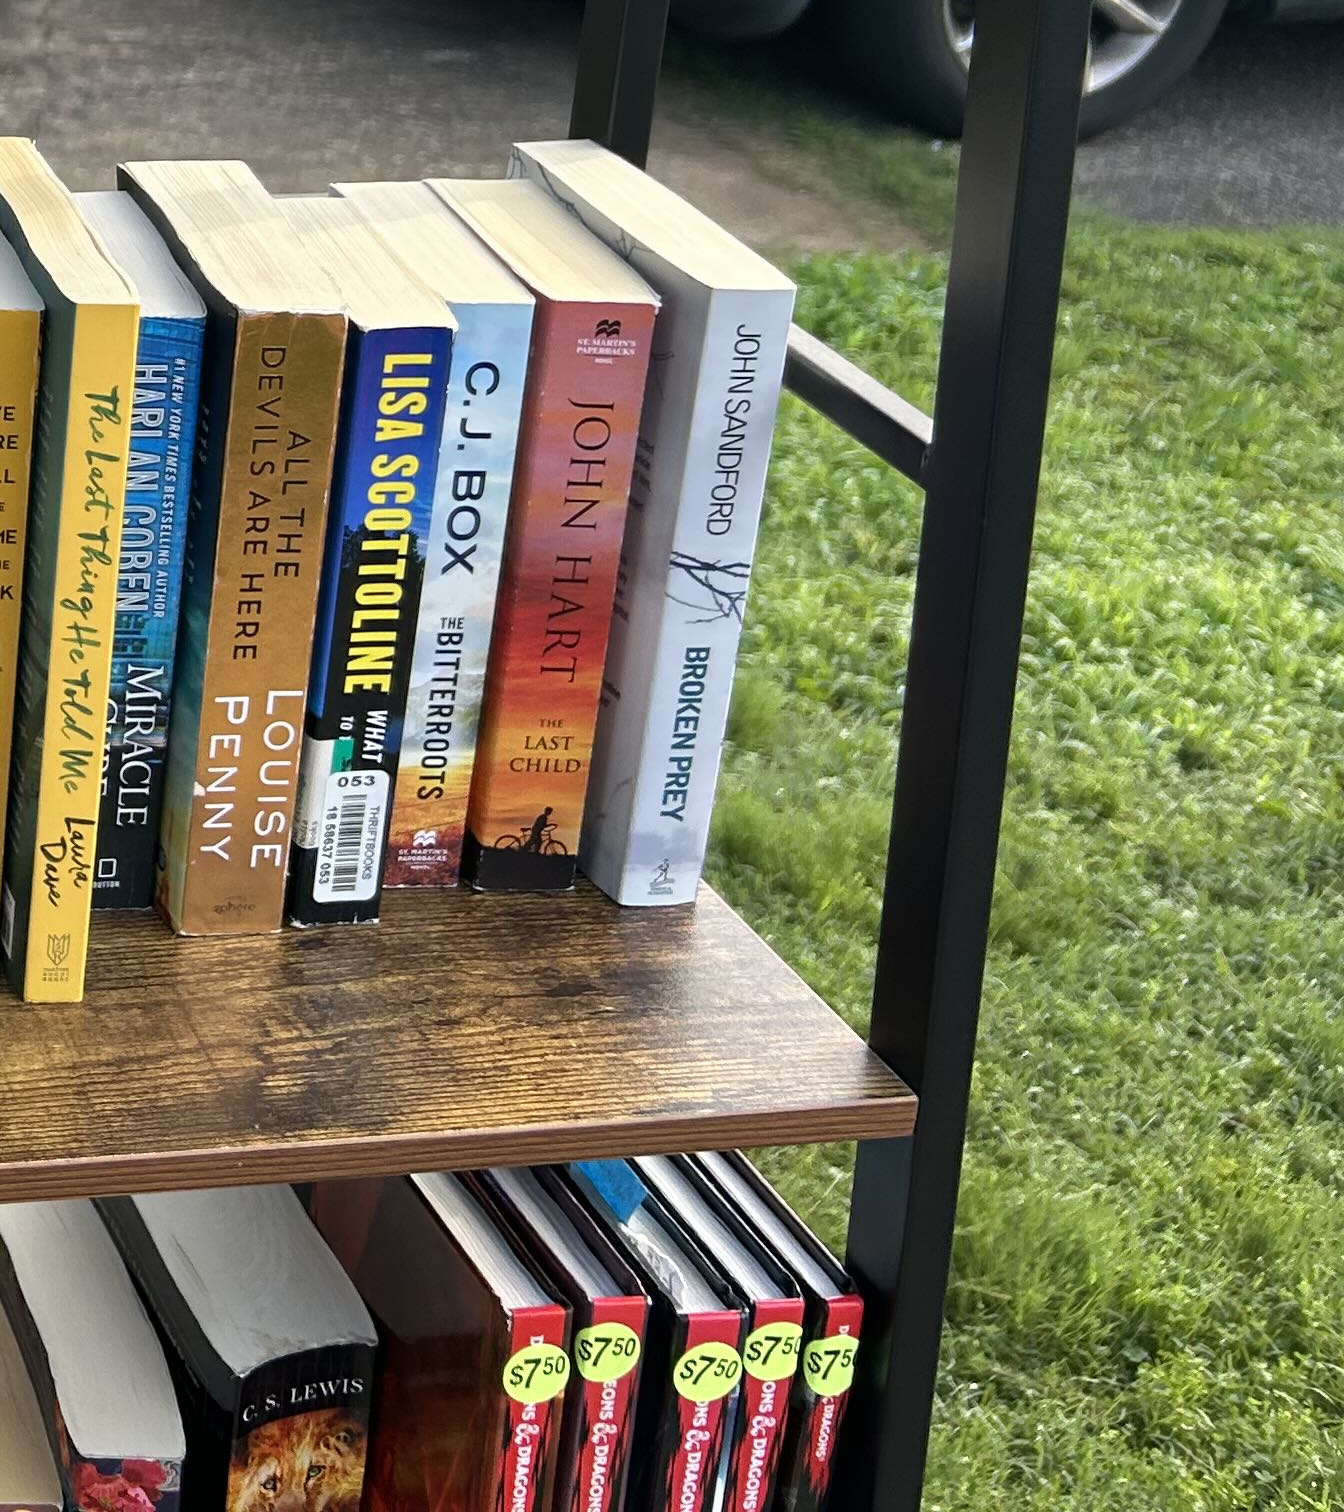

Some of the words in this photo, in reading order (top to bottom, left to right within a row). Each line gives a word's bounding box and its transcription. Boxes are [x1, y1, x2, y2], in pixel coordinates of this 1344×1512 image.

[727, 323, 762, 394] JOHN
[250, 346, 287, 476] DEVILS
[374, 353, 433, 442] LISA
[281, 429, 312, 496] ALL
[559, 397, 616, 532] JOHN
[705, 398, 749, 536] SANDFORD
[242, 491, 271, 556] ARE
[273, 508, 306, 578] THE
[343, 453, 421, 696] SCOTTOLINE
[232, 572, 265, 661] HERE
[439, 616, 465, 630] THE
[540, 554, 593, 683] HART
[416, 632, 465, 801] BITTERROOTS
[538, 718, 564, 729] THE
[669, 646, 711, 750] BROKEN
[199, 696, 250, 861] PENNY
[509, 757, 581, 774] CHILD
[524, 735, 575, 751] LAST
[250, 690, 304, 869] LOUISE
[337, 775, 376, 788] 053
[659, 754, 693, 822] PREY
[362, 806, 380, 880] THRIFTBOOKS
[242, 1404, 258, 1422] C.
[265, 1394, 281, 1411] S.
[290, 1377, 364, 1403] LEWIS
[815, 1404, 834, 1462] DRAGONS
[742, 1438, 768, 1510] DRAGONS
